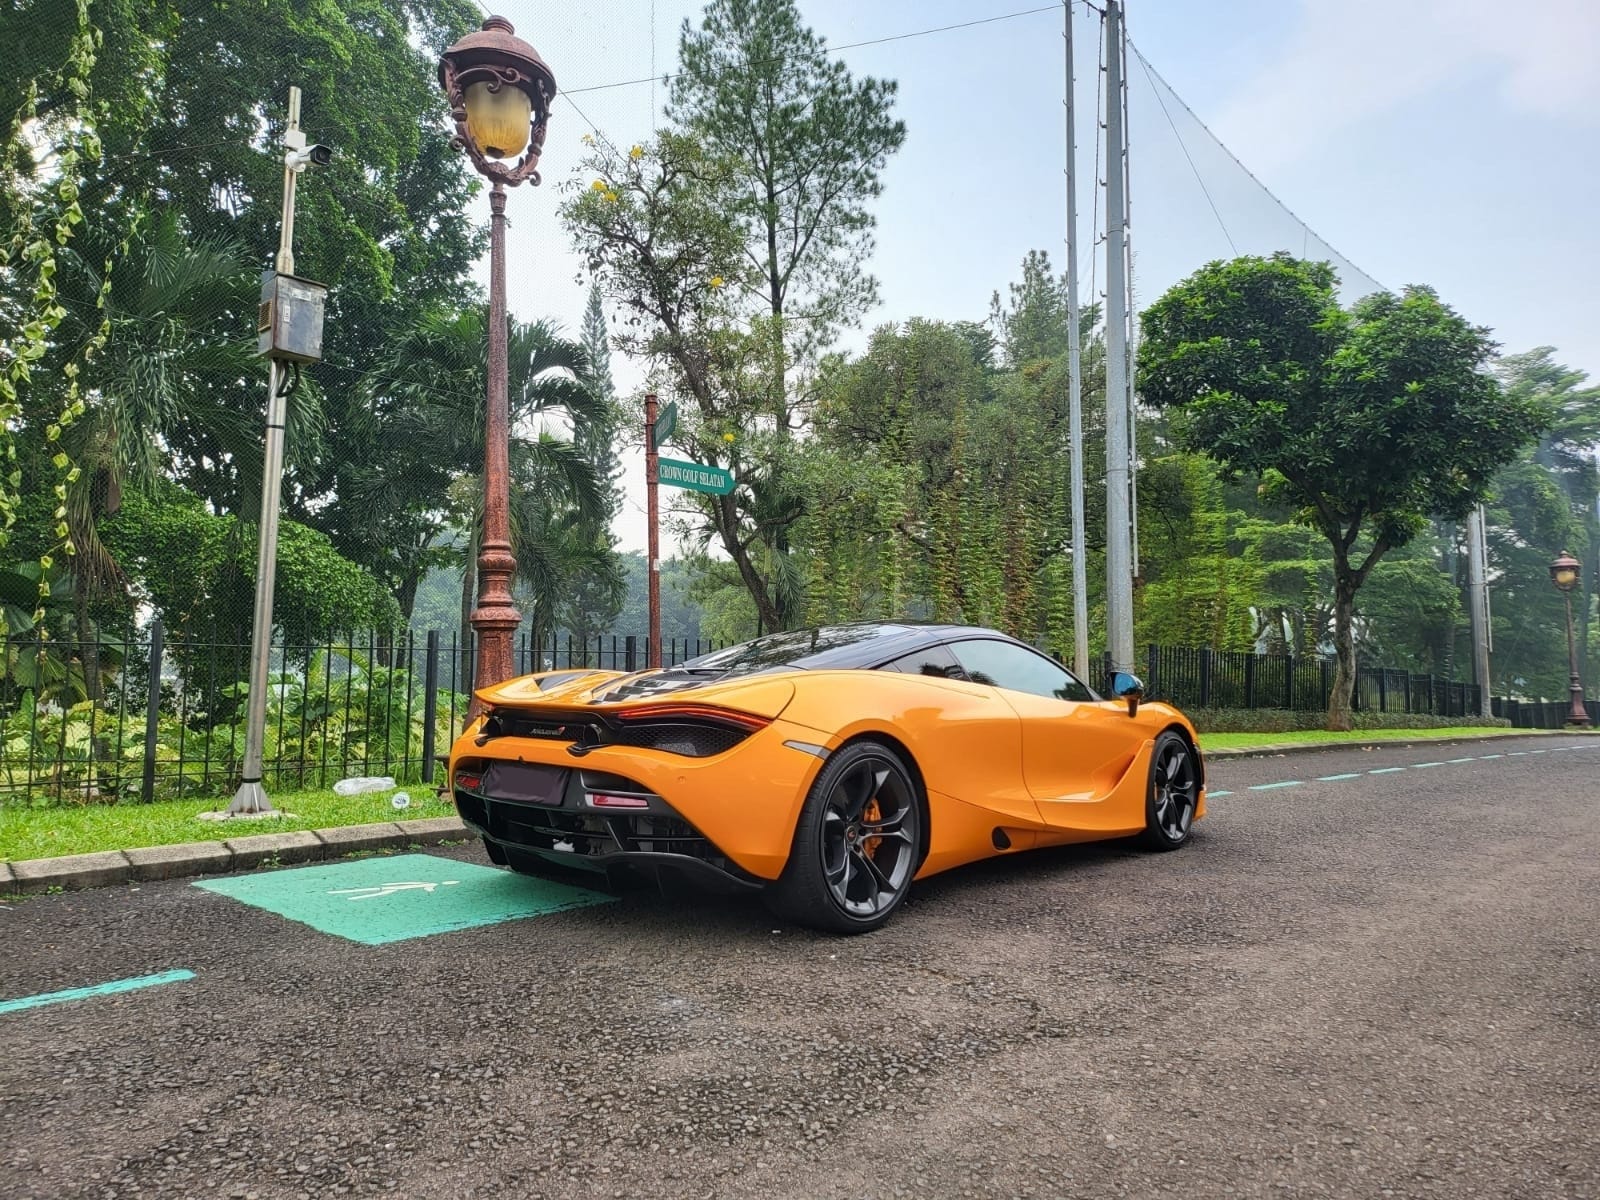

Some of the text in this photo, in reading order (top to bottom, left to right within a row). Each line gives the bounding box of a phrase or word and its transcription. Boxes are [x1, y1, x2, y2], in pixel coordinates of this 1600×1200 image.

[660, 465, 725, 488] CROWN GOLF SELATAN
